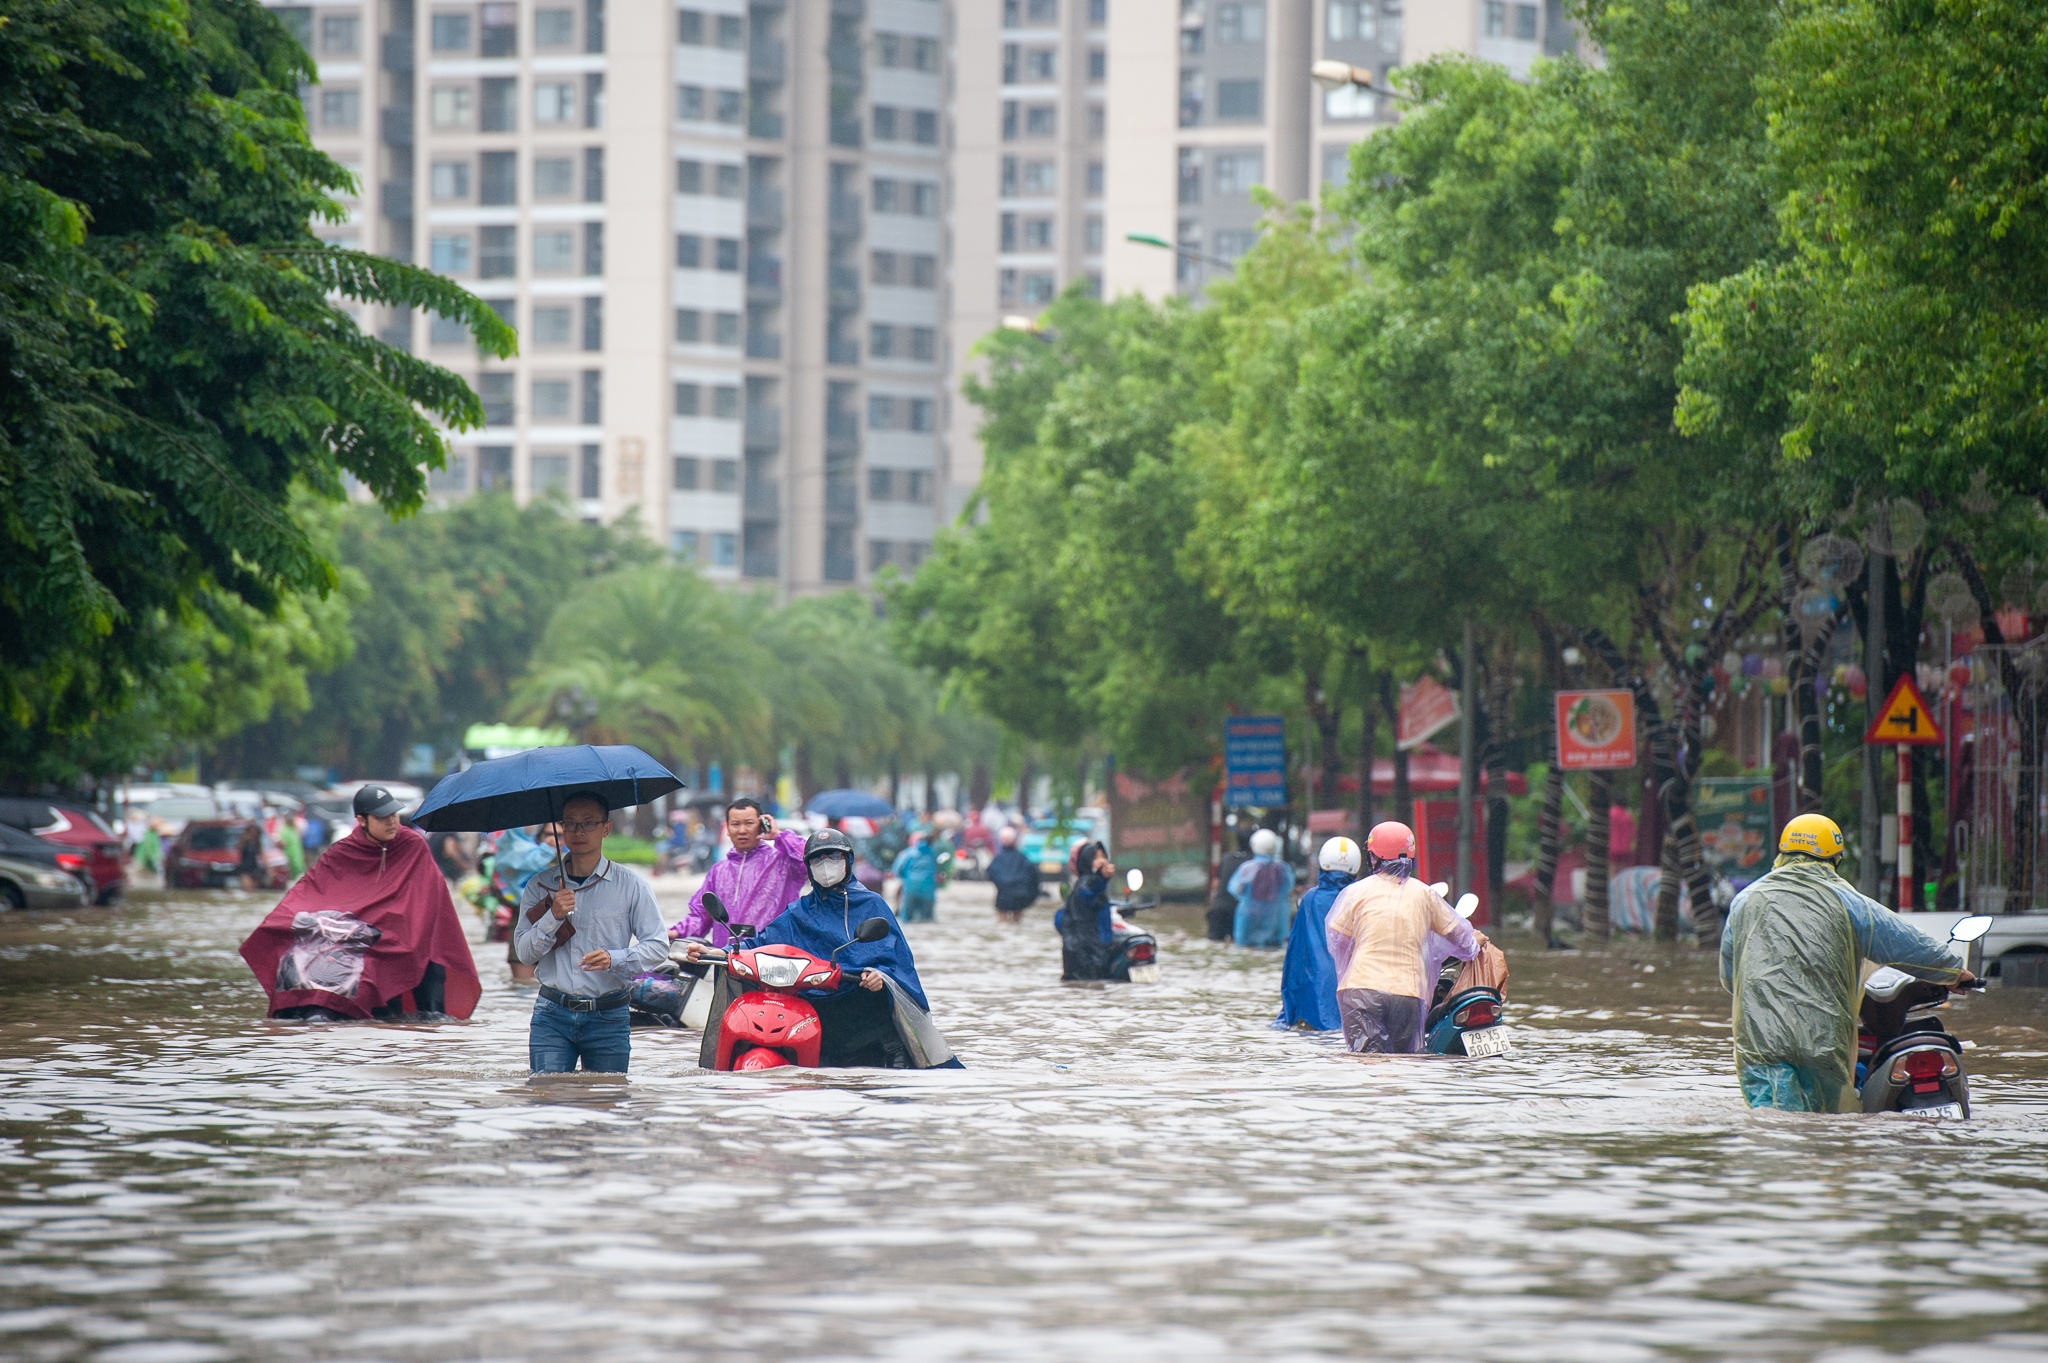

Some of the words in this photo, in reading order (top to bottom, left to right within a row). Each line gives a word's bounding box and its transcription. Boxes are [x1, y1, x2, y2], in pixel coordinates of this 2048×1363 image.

[762, 999, 785, 1007] HONDA
[1468, 1028, 1500, 1044] 29-X5
[1469, 1040, 1508, 1057] 580.26
